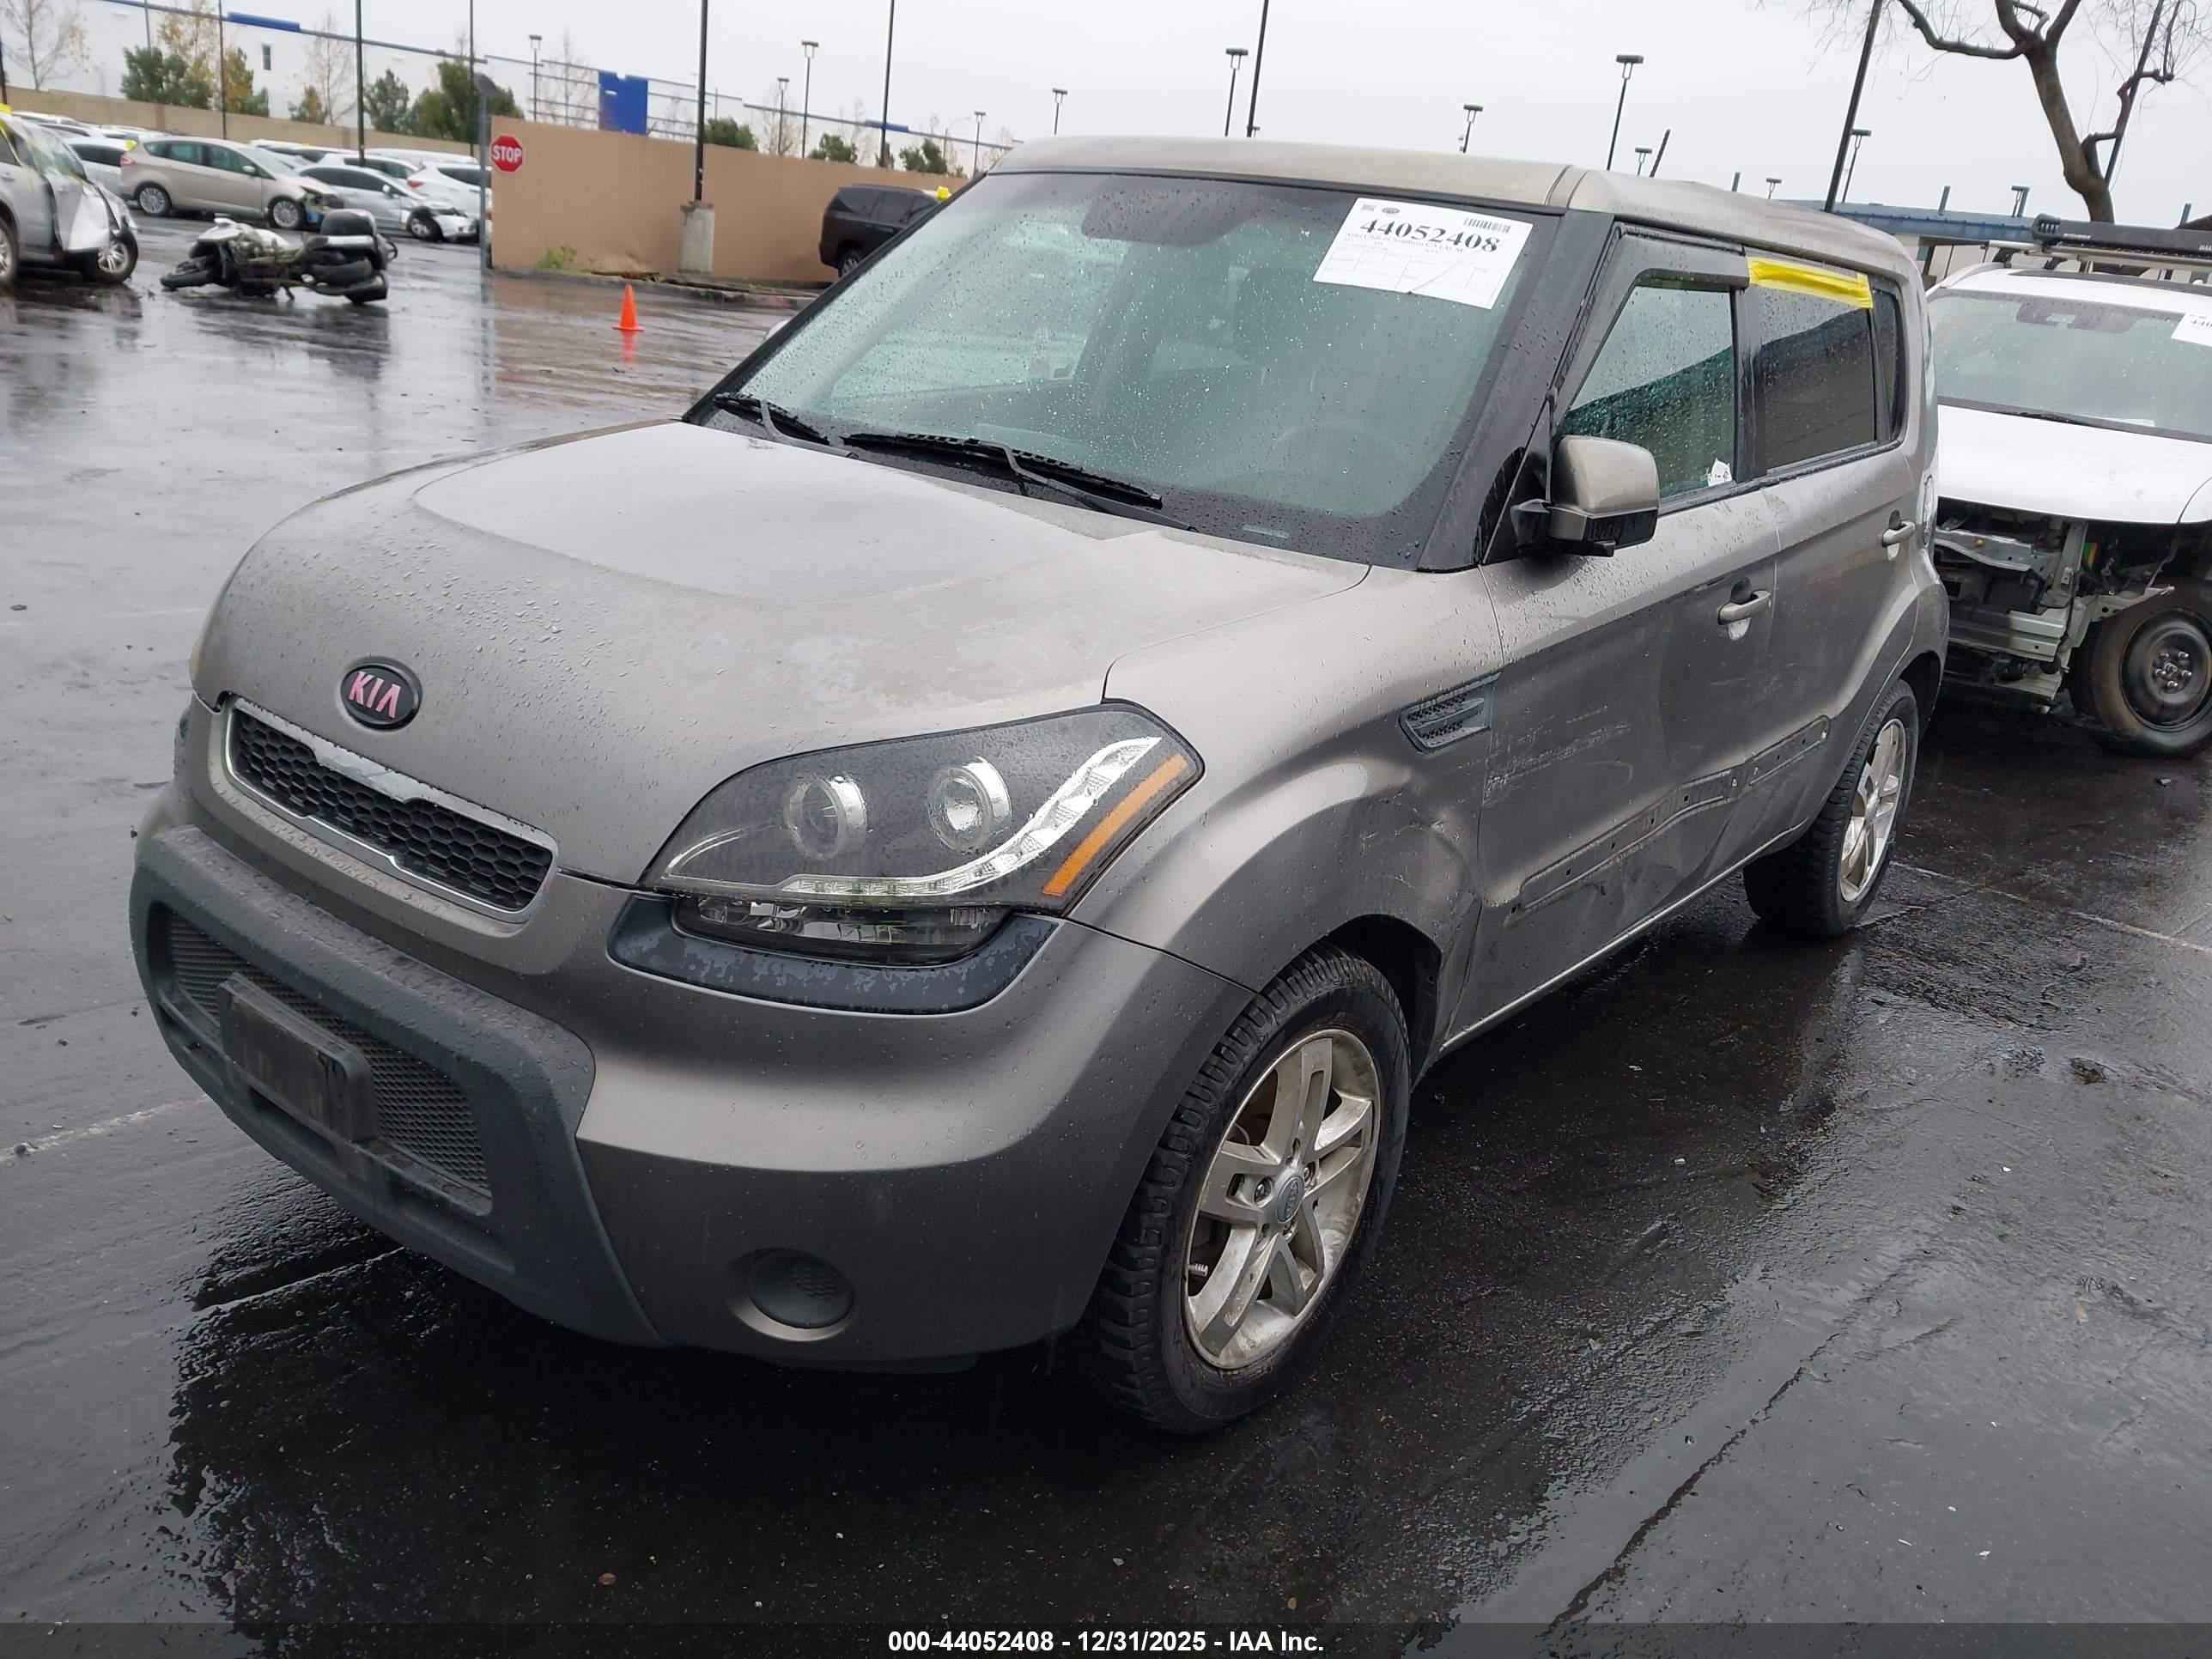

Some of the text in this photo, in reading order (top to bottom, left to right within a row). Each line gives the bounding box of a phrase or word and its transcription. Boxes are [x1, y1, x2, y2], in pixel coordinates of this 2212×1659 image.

[493, 144, 522, 162] STOP
[1360, 218, 1500, 252] 44052408
[349, 671, 401, 718] KIA
